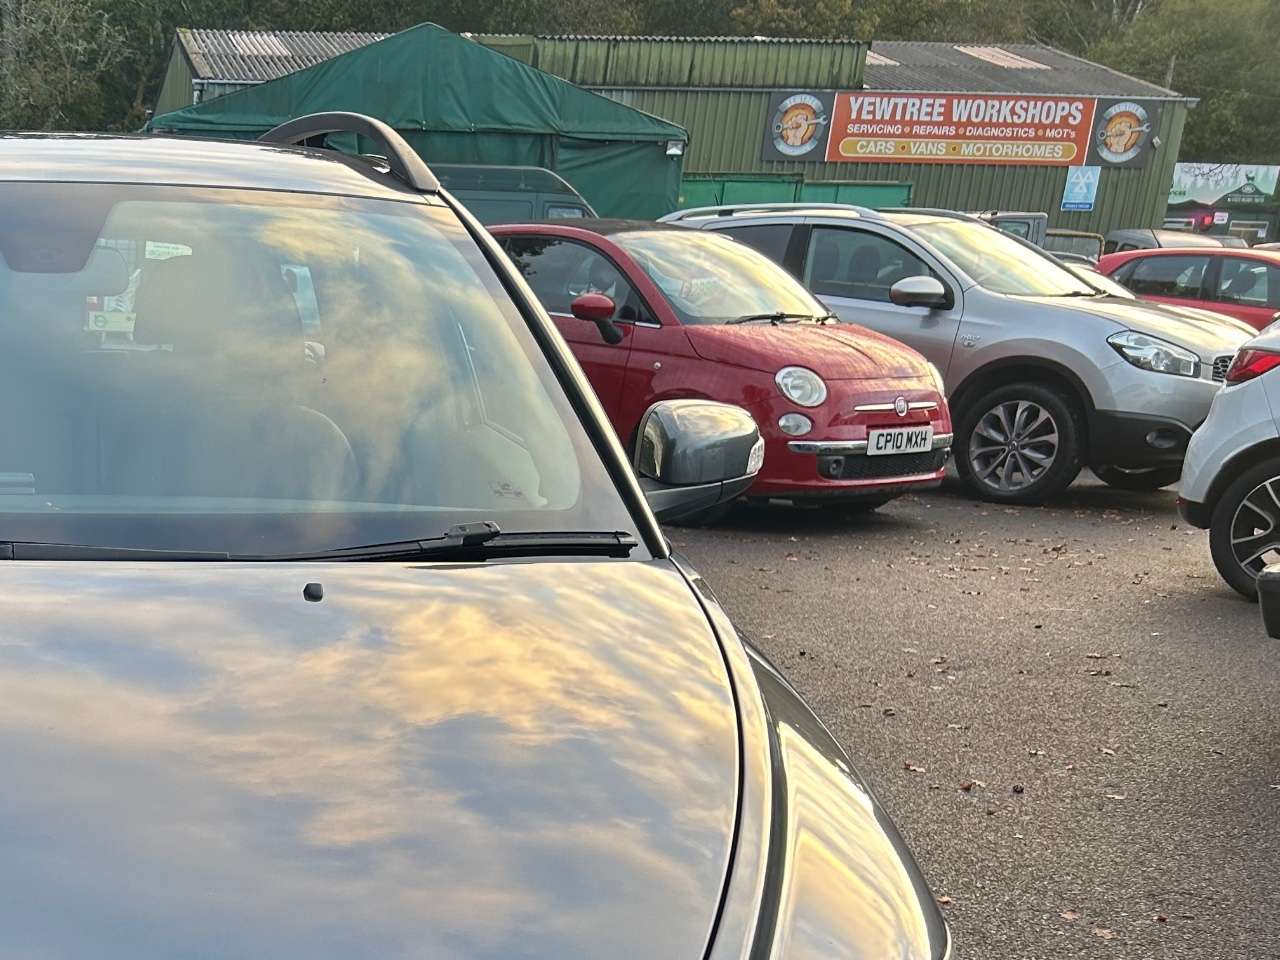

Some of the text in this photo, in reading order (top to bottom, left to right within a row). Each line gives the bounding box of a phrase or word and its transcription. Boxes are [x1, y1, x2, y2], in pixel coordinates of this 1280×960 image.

[849, 96, 946, 122] YEWTREE
[952, 99, 1084, 125] WORKSHOPS
[847, 124, 1076, 139] SERVICING REPAIRS DIAGNOSTICS MOT's
[856, 141, 1063, 157] CARS VANS MOTORHOMES
[876, 430, 927, 450] CP10 MXH
